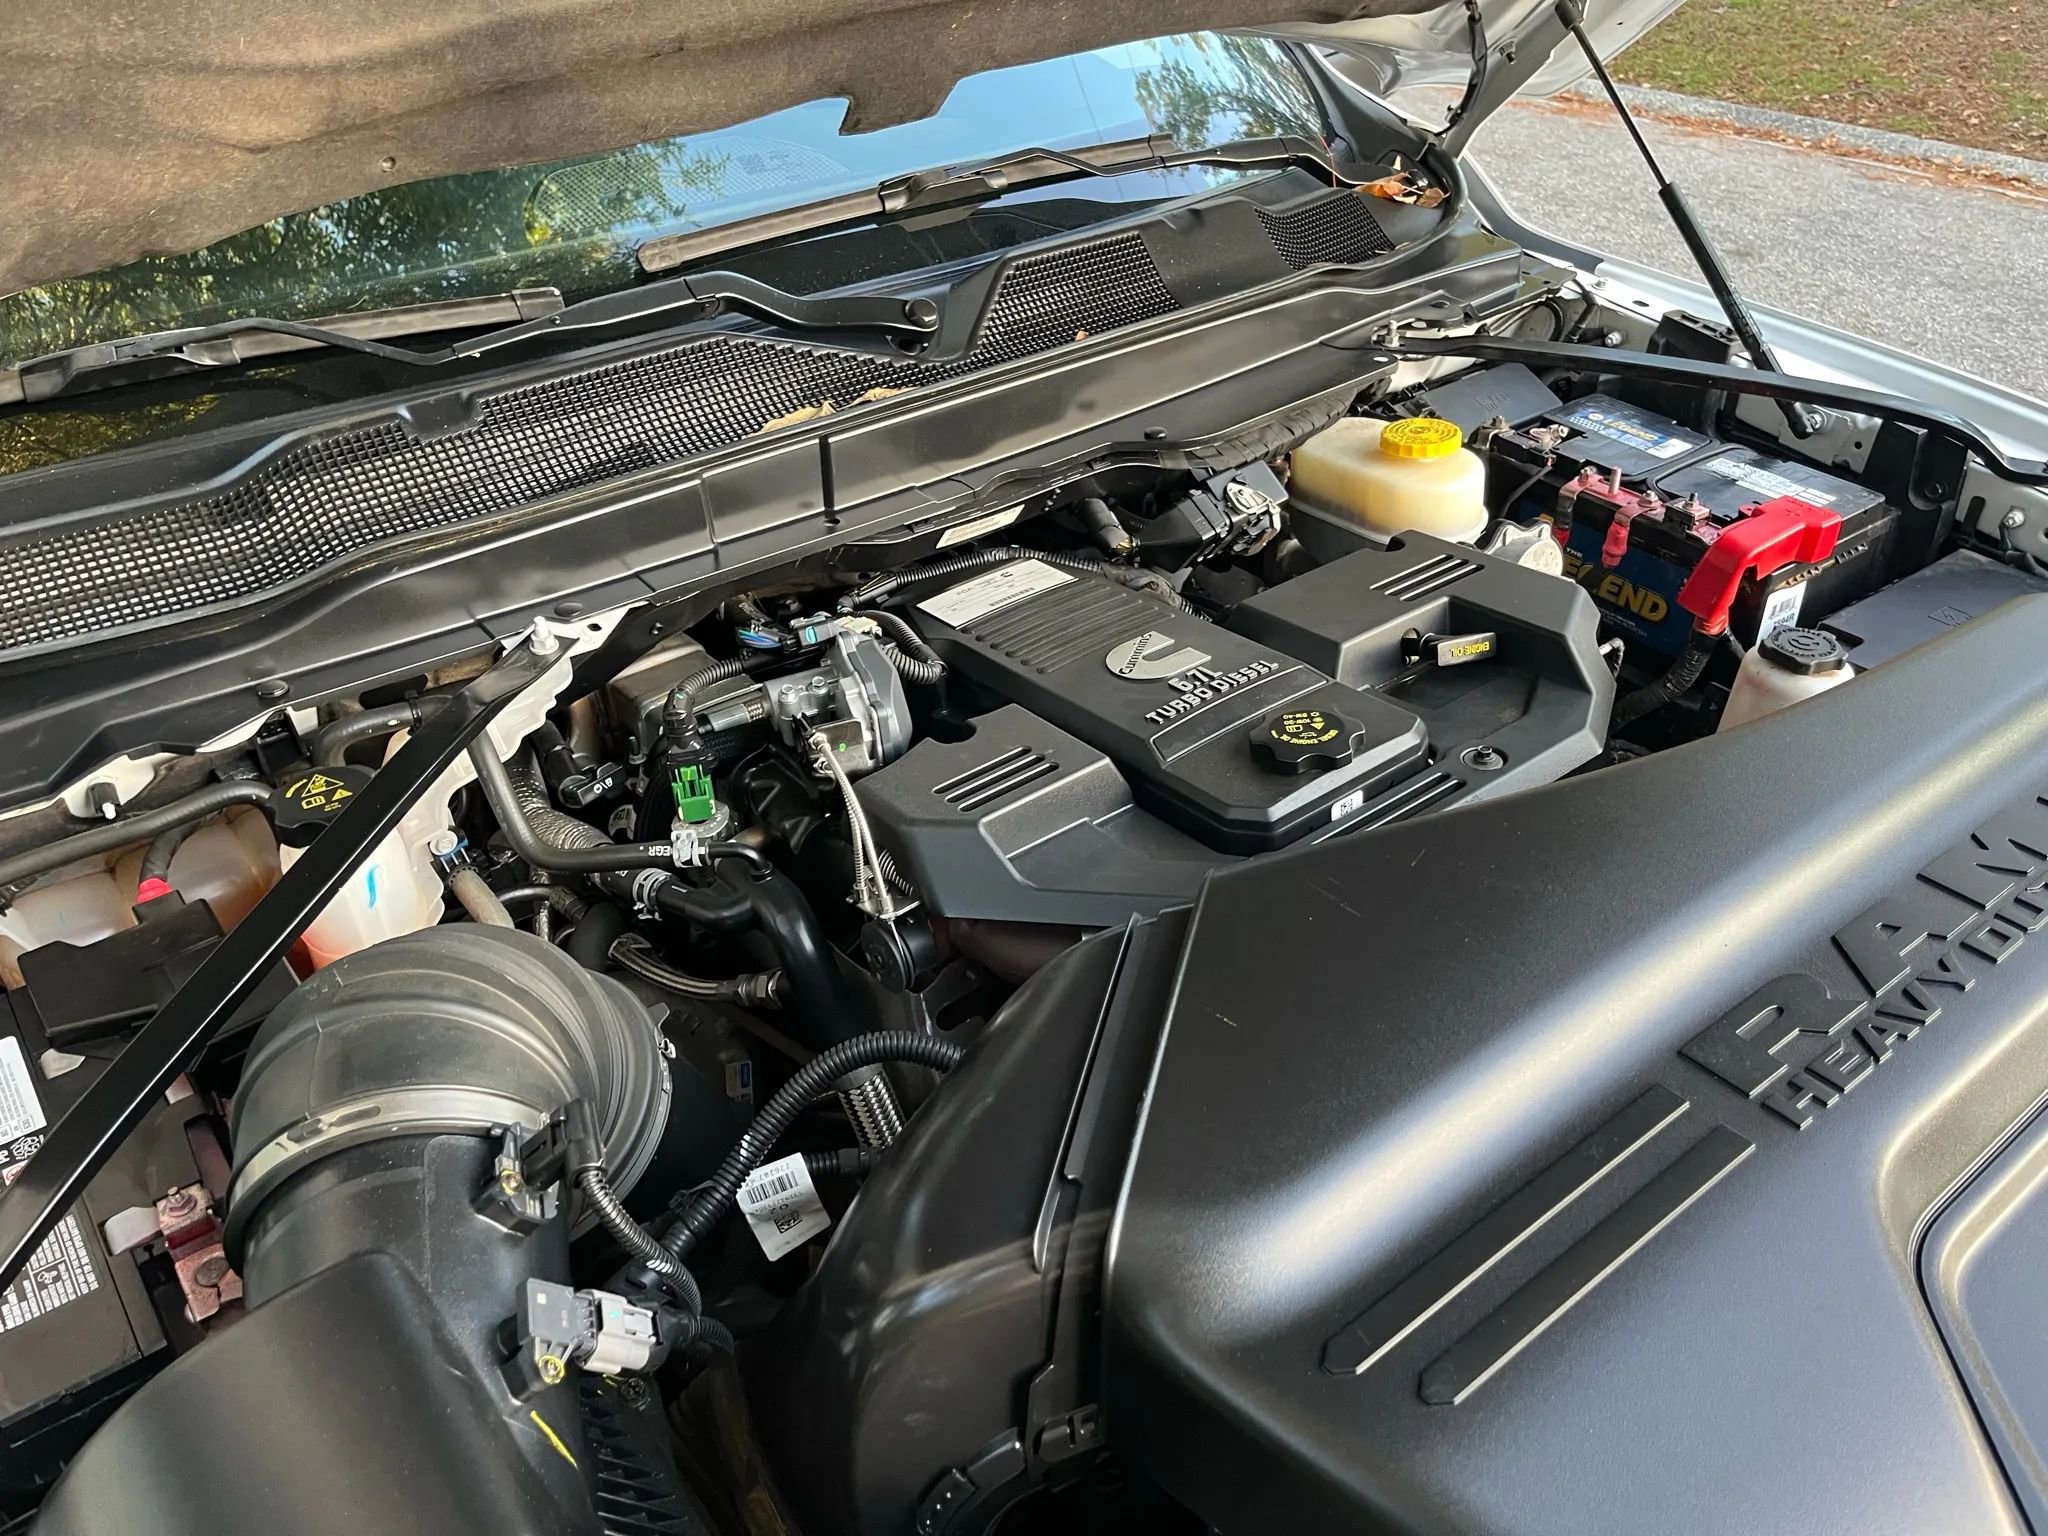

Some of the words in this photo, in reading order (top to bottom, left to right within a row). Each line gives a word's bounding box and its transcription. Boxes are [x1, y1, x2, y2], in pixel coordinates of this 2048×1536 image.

[1565, 546, 1583, 558] THE
[1556, 541, 1668, 623] EEND
[1117, 632, 1153, 675] Cummins
[1450, 647, 1463, 657] OIL
[1465, 641, 1490, 655] ENGINE
[1144, 688, 1213, 725] TURBO
[1209, 660, 1280, 693] DIESEL
[1168, 666, 1224, 693] 6.7L
[647, 845, 671, 856] EGR
[1677, 802, 2048, 1098] RAM
[1761, 949, 1976, 1131] HEAVY
[1960, 869, 2048, 965] DU
